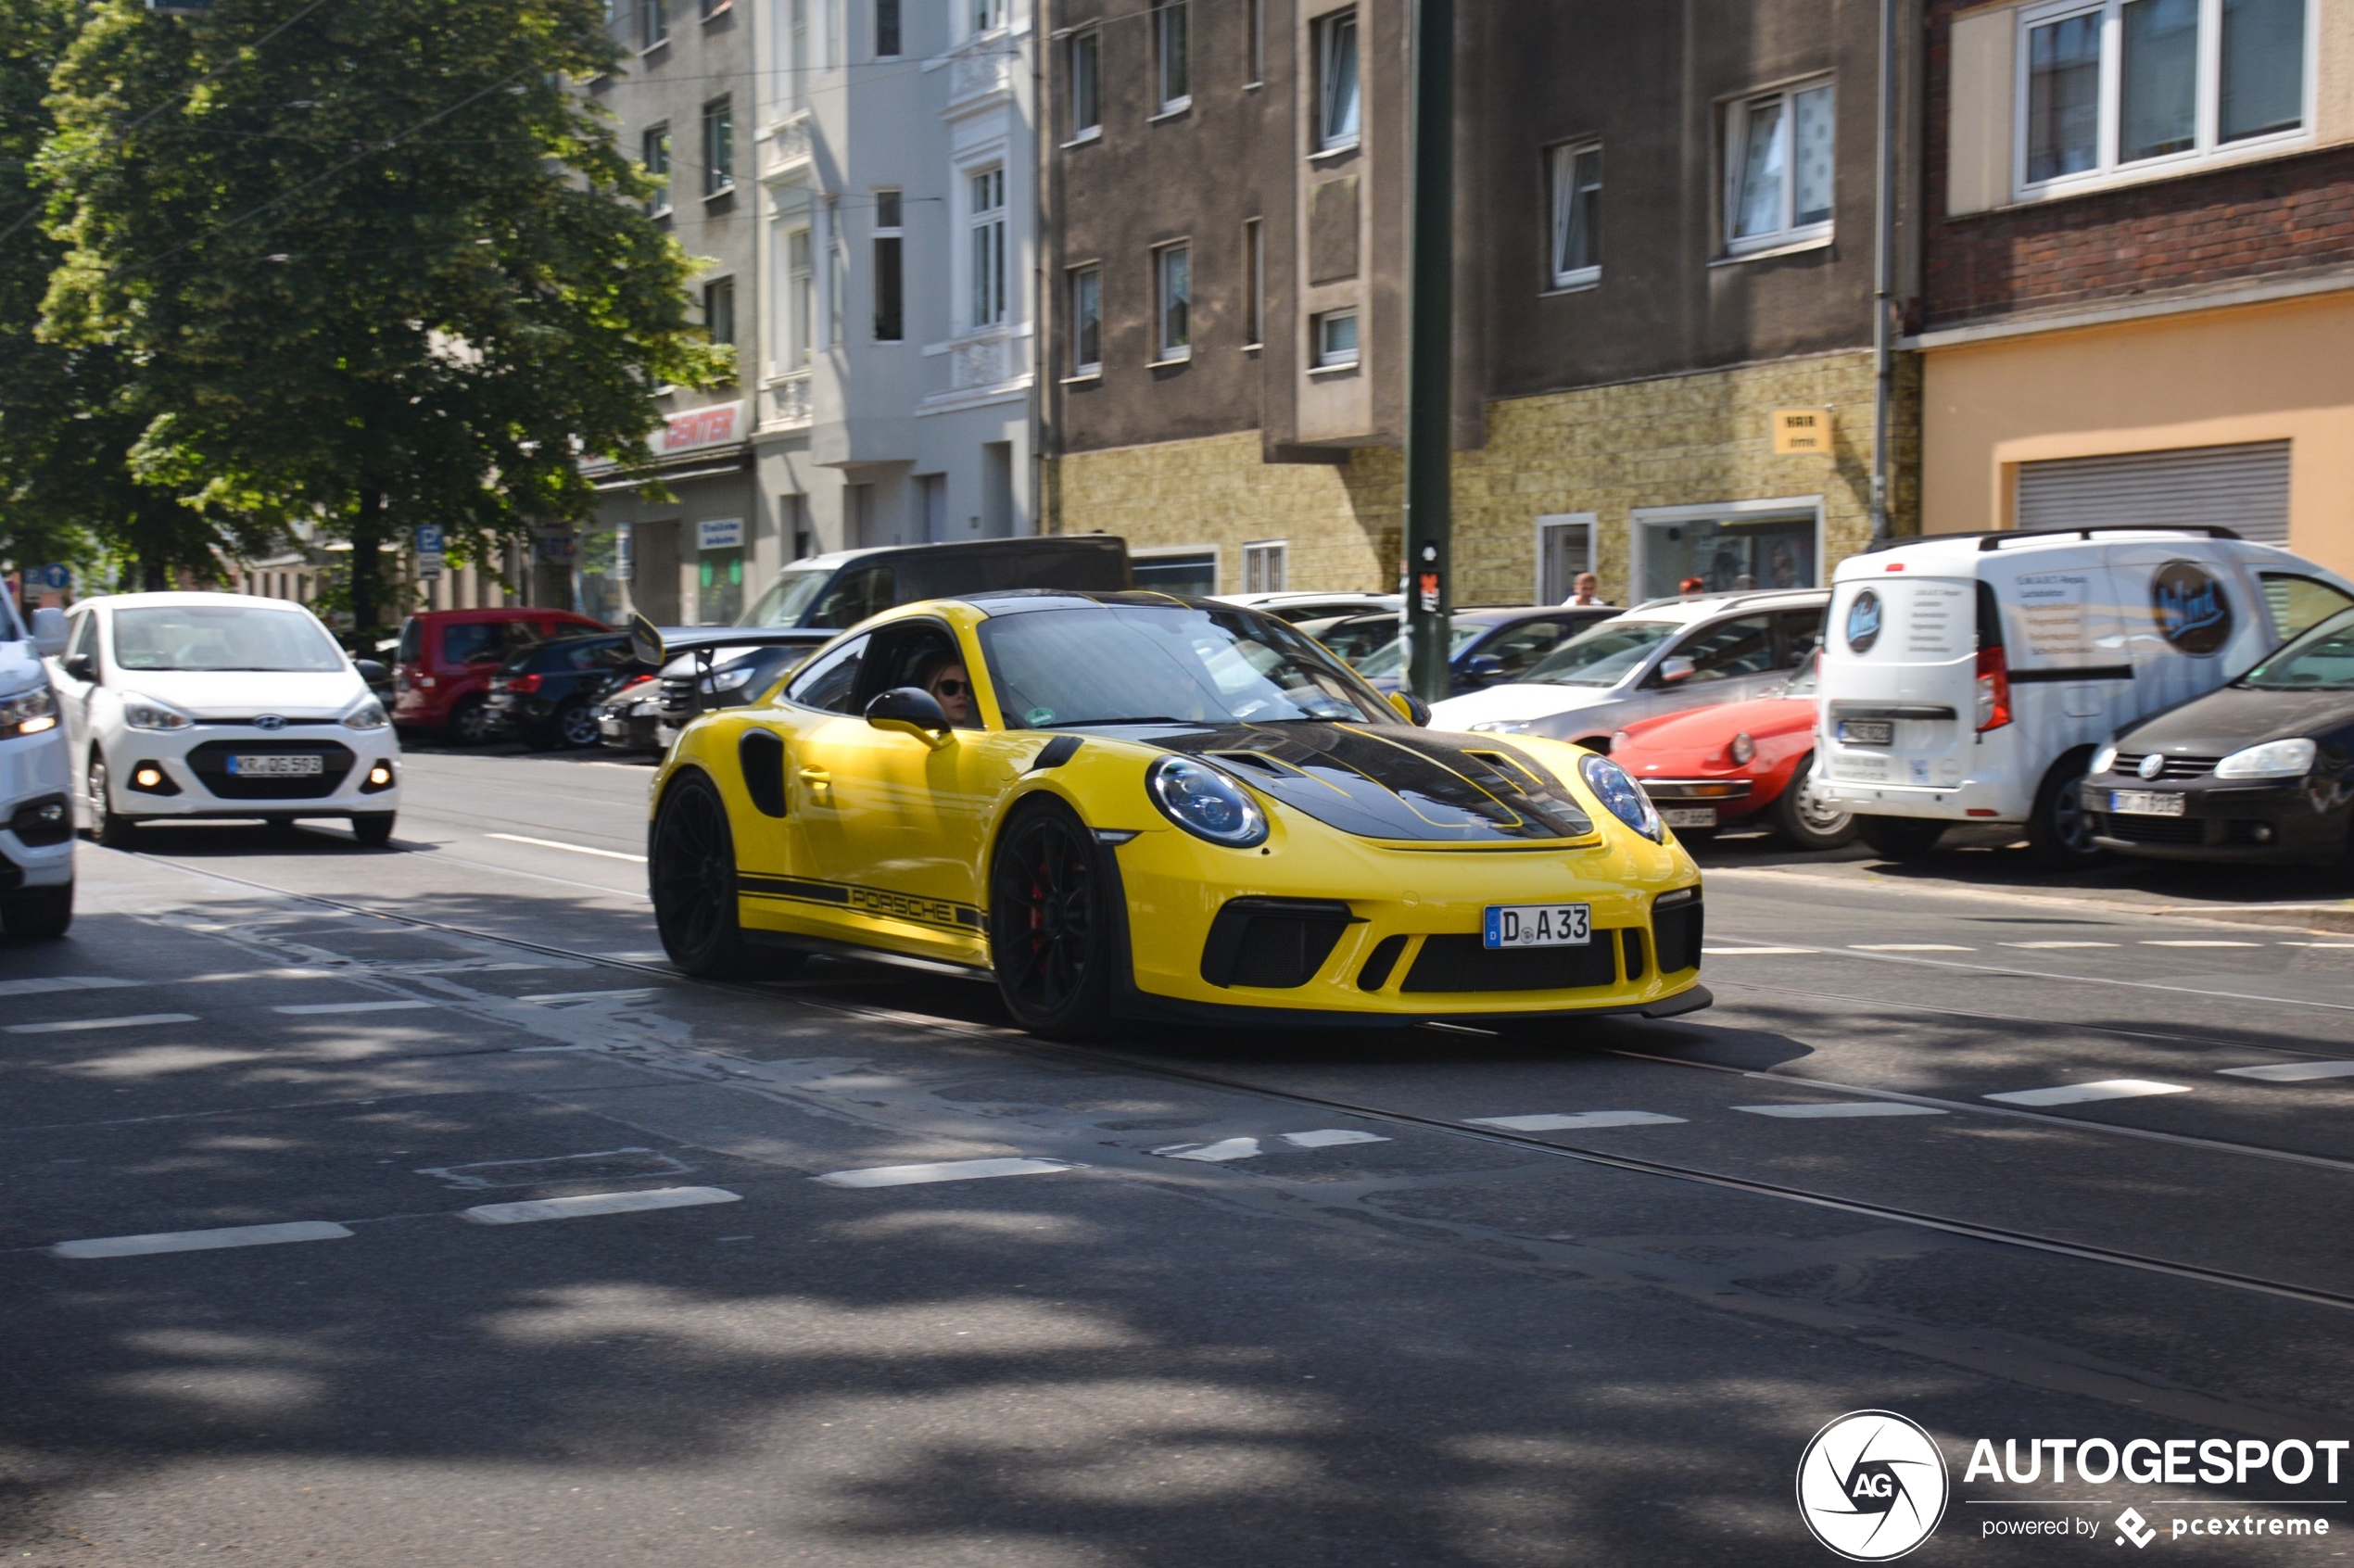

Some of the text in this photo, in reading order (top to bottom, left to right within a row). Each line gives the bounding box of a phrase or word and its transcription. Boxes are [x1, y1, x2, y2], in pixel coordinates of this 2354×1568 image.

[664, 407, 735, 450] CENTER
[1787, 416, 1814, 428] HAIR
[853, 890, 952, 922] PORSCHE
[1502, 909, 1588, 942] D A 33
